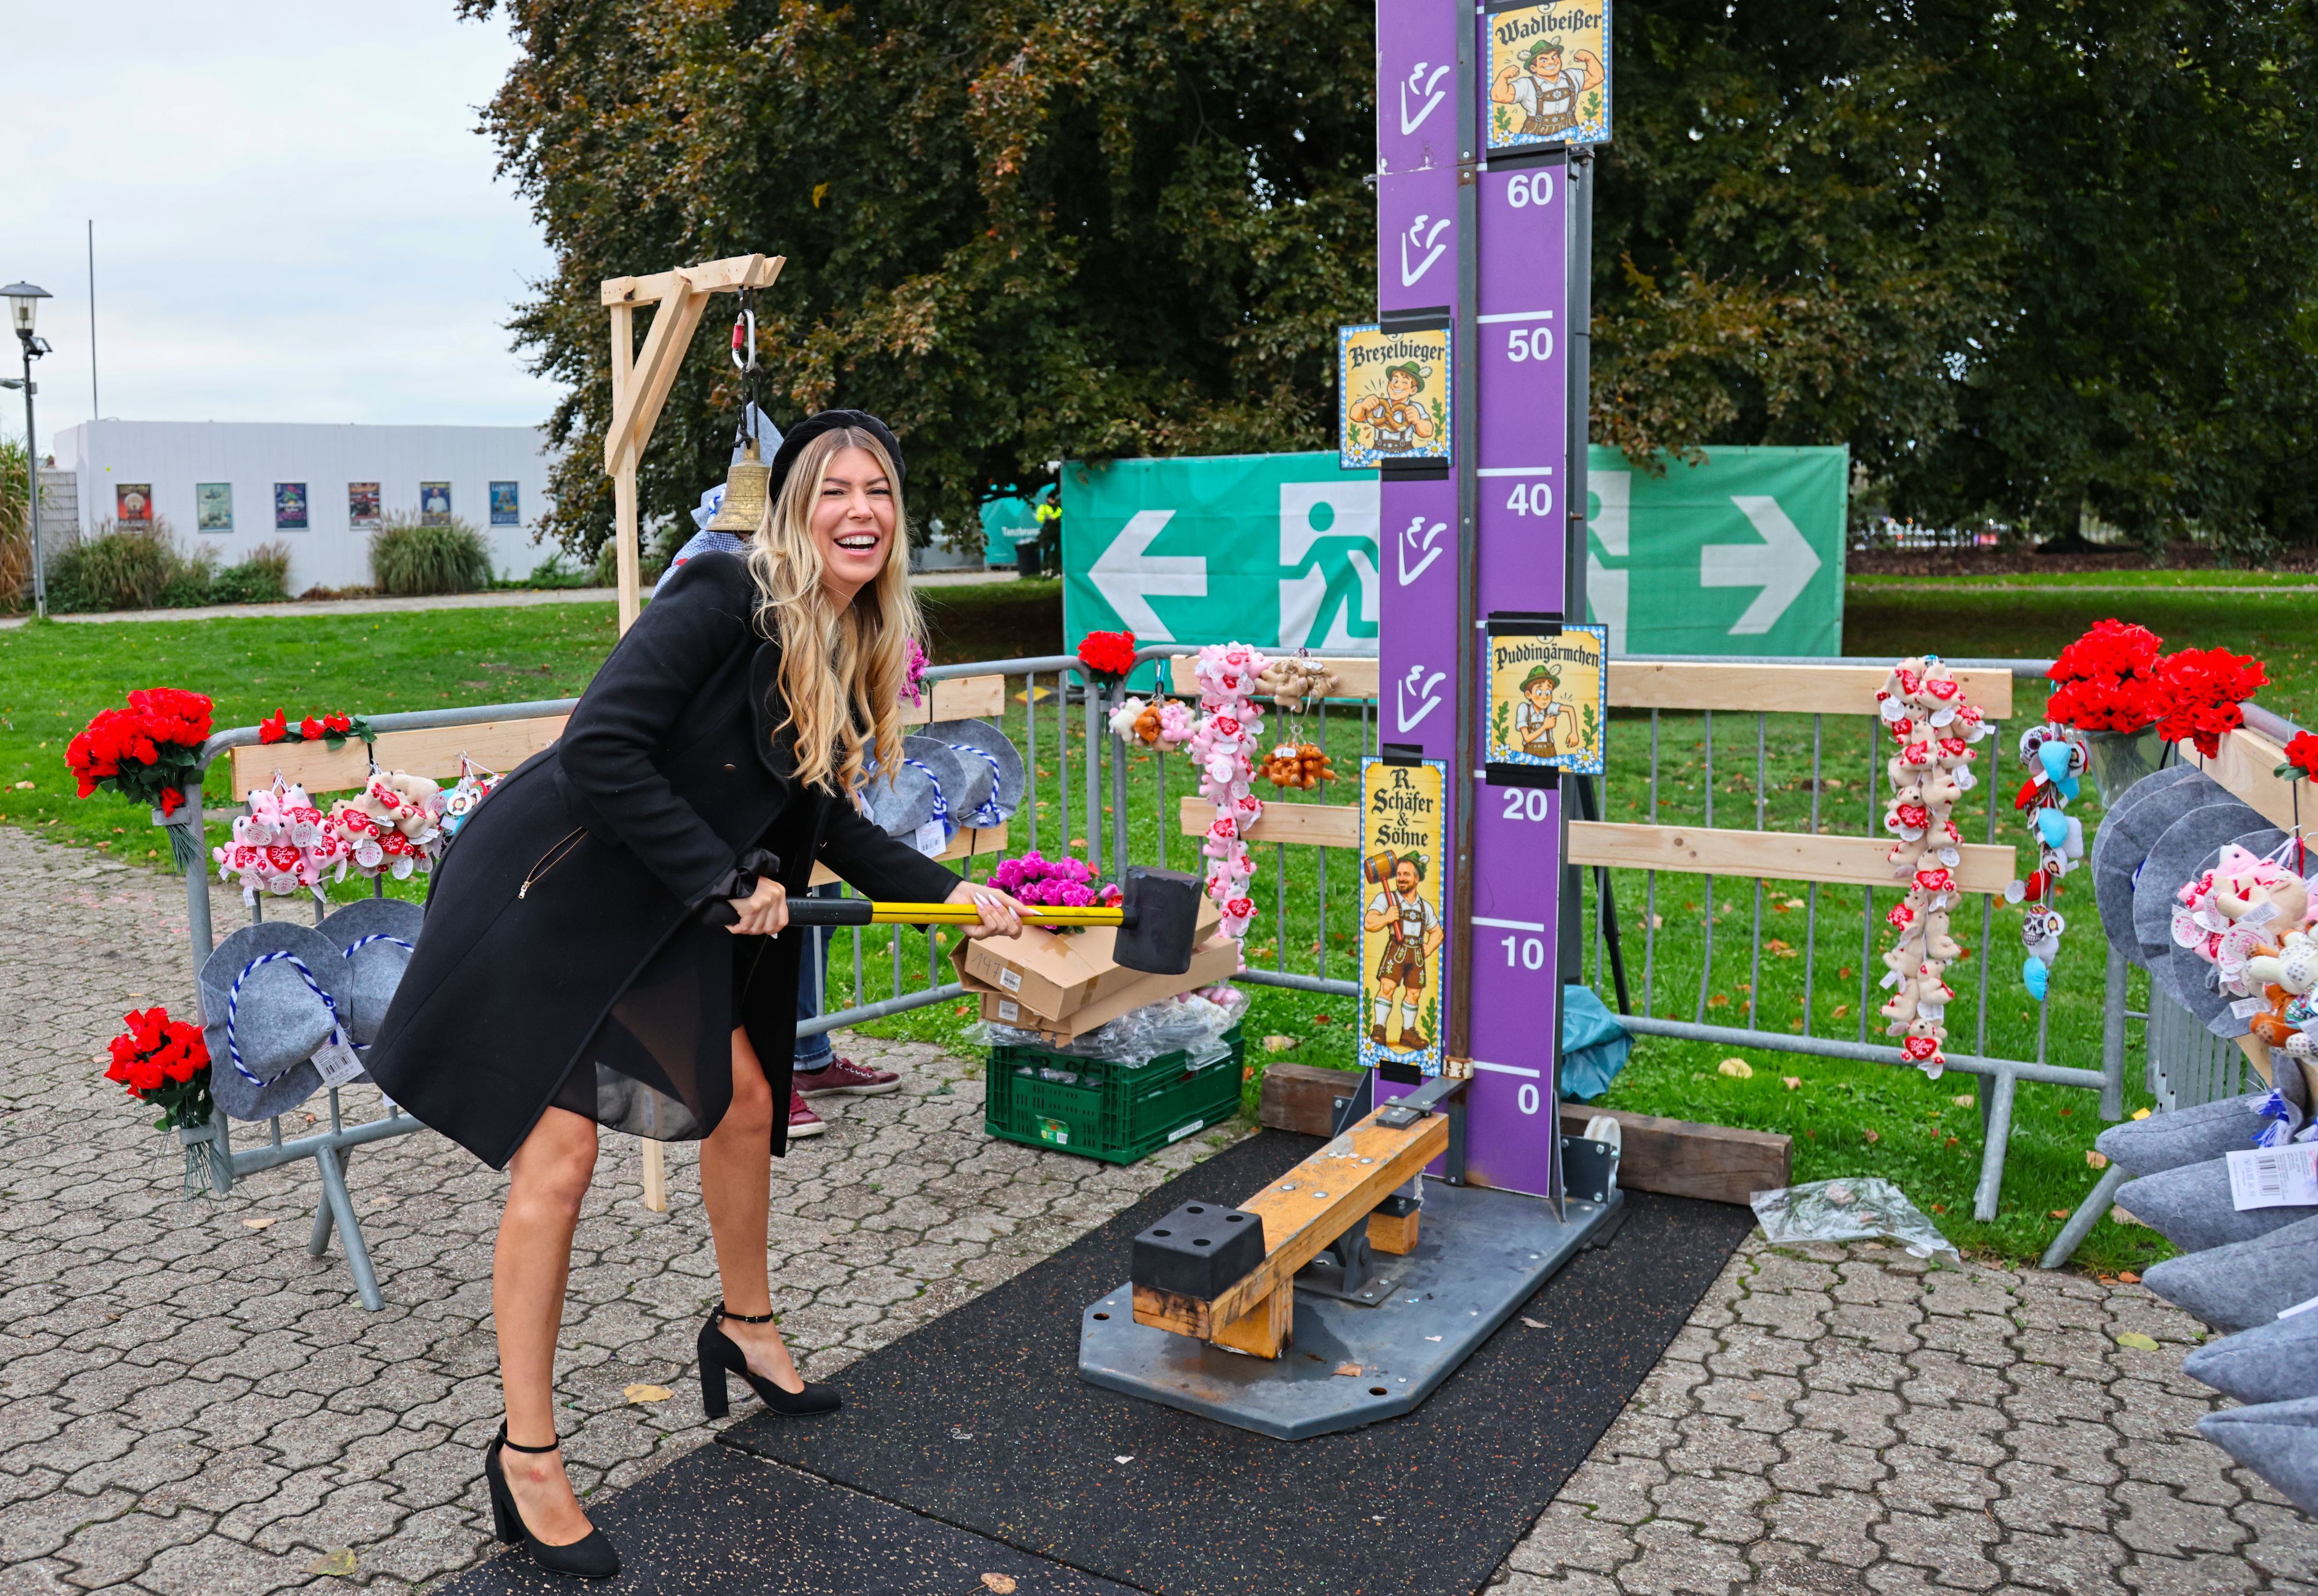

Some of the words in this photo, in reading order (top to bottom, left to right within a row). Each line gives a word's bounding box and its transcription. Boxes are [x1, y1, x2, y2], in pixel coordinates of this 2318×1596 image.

[1495, 9, 1603, 46] Wadlbeißer
[1507, 172, 1554, 208] 60
[1348, 339, 1446, 371] Brezelbieger
[1507, 327, 1553, 362] 50
[1507, 483, 1552, 516] 40
[1494, 643, 1599, 673] Puddingärmchen
[1390, 767, 1416, 791] R.
[1371, 788, 1434, 817] Schäfer
[1503, 788, 1548, 822] 20
[1397, 812, 1409, 827] &
[385, 843, 399, 851] You
[386, 835, 403, 843] Love
[1374, 824, 1429, 850] Söhne
[271, 848, 278, 857] I
[278, 848, 296, 856] Love
[276, 855, 290, 865] You
[971, 953, 1001, 979] 147
[1501, 936, 1544, 970] 10
[1518, 1084, 1539, 1114] 0
